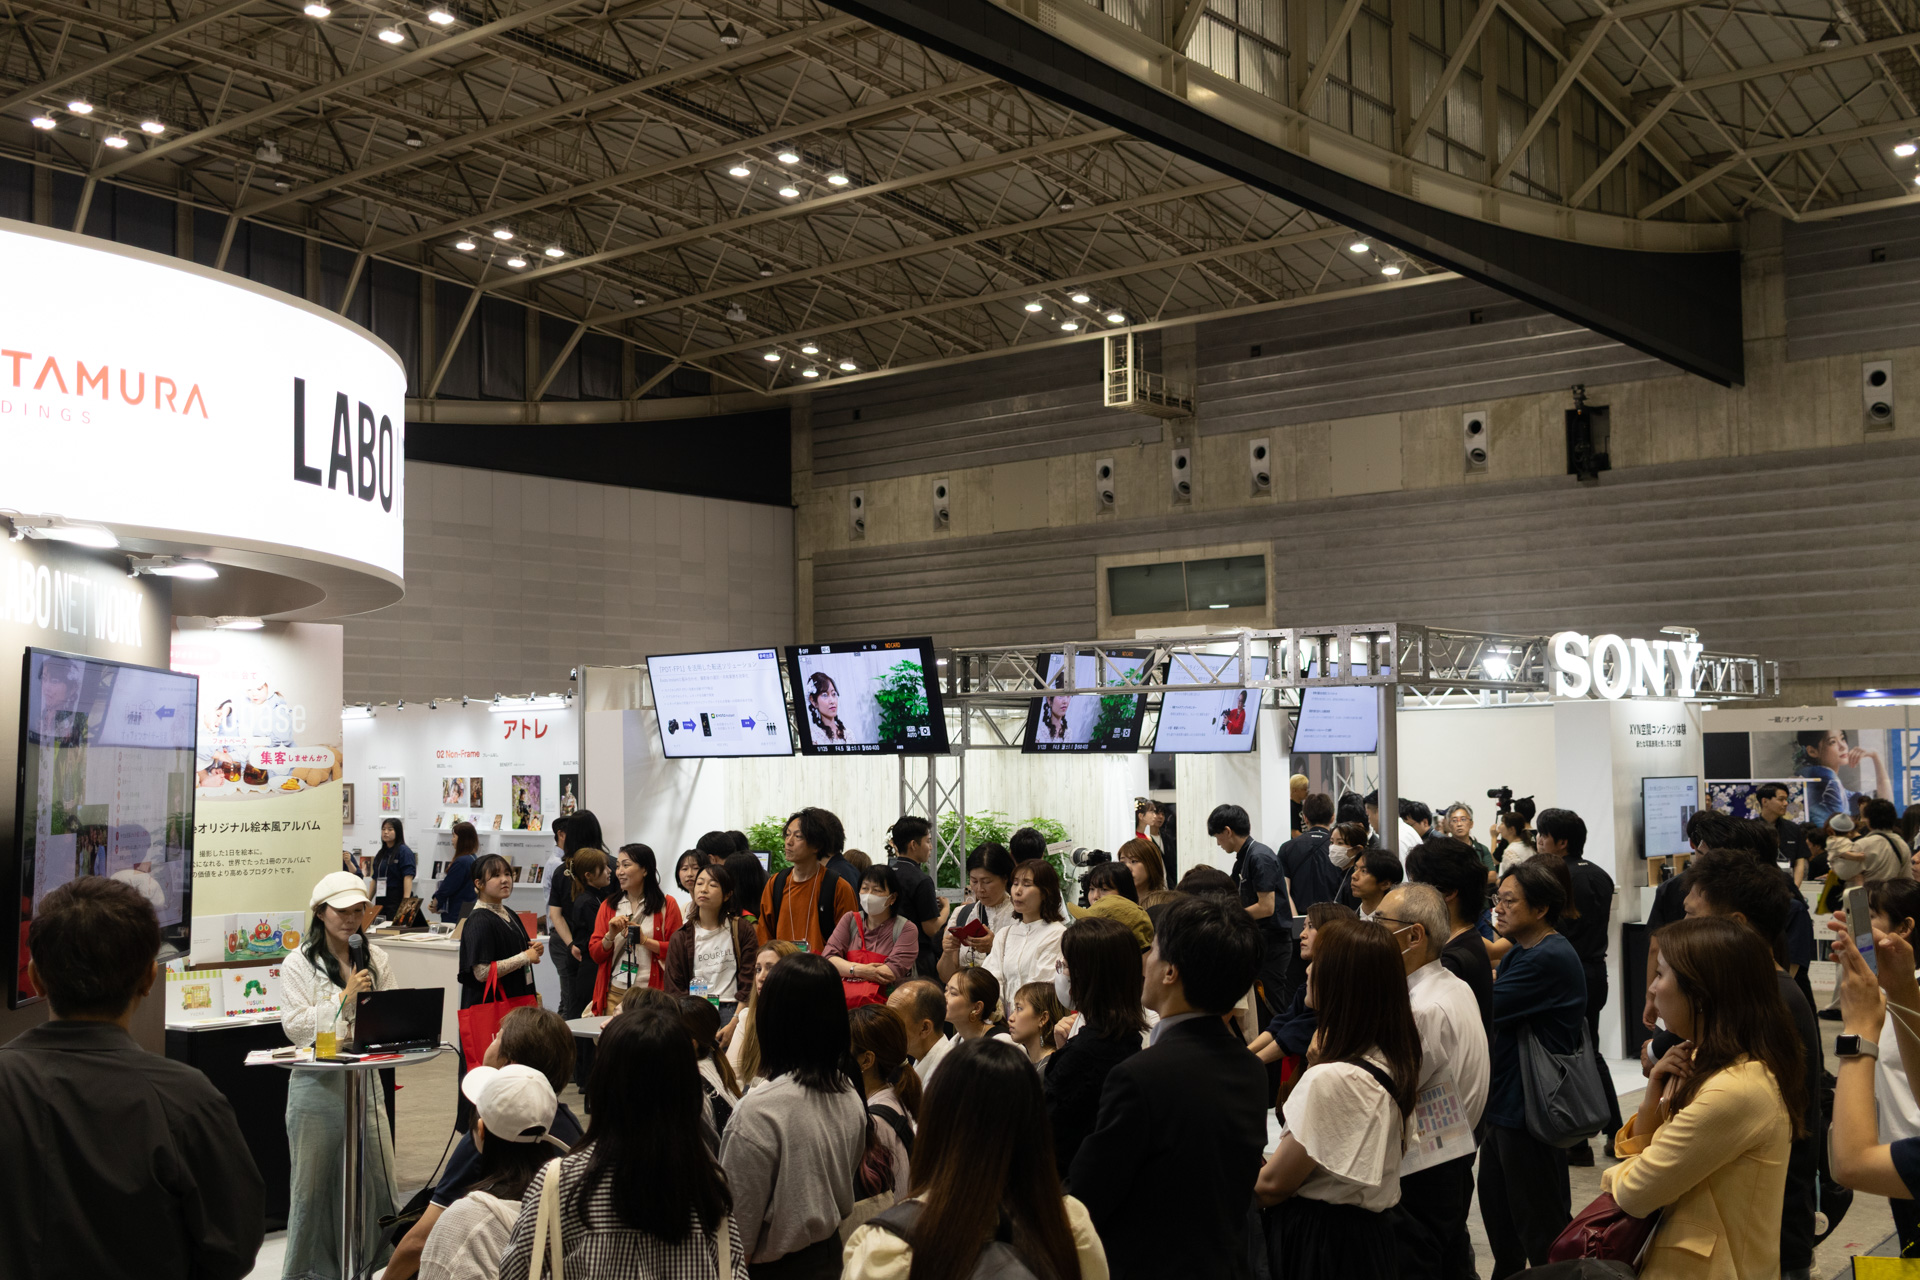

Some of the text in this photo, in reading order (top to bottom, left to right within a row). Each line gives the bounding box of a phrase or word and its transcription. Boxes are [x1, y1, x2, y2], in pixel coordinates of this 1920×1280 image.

[1, 348, 209, 419] TAMURA
[293, 376, 394, 514] LABO
[0, 556, 143, 648] ABO NETWORK
[1548, 631, 1704, 700] SONY
[503, 718, 548, 740] アトレ
[212, 737, 248, 745] フォトベース
[260, 751, 329, 766] 集客しませんか?
[436, 749, 480, 759] 02 Non-Frame
[199, 848, 263, 858] 撮影した1日を絵本に。
